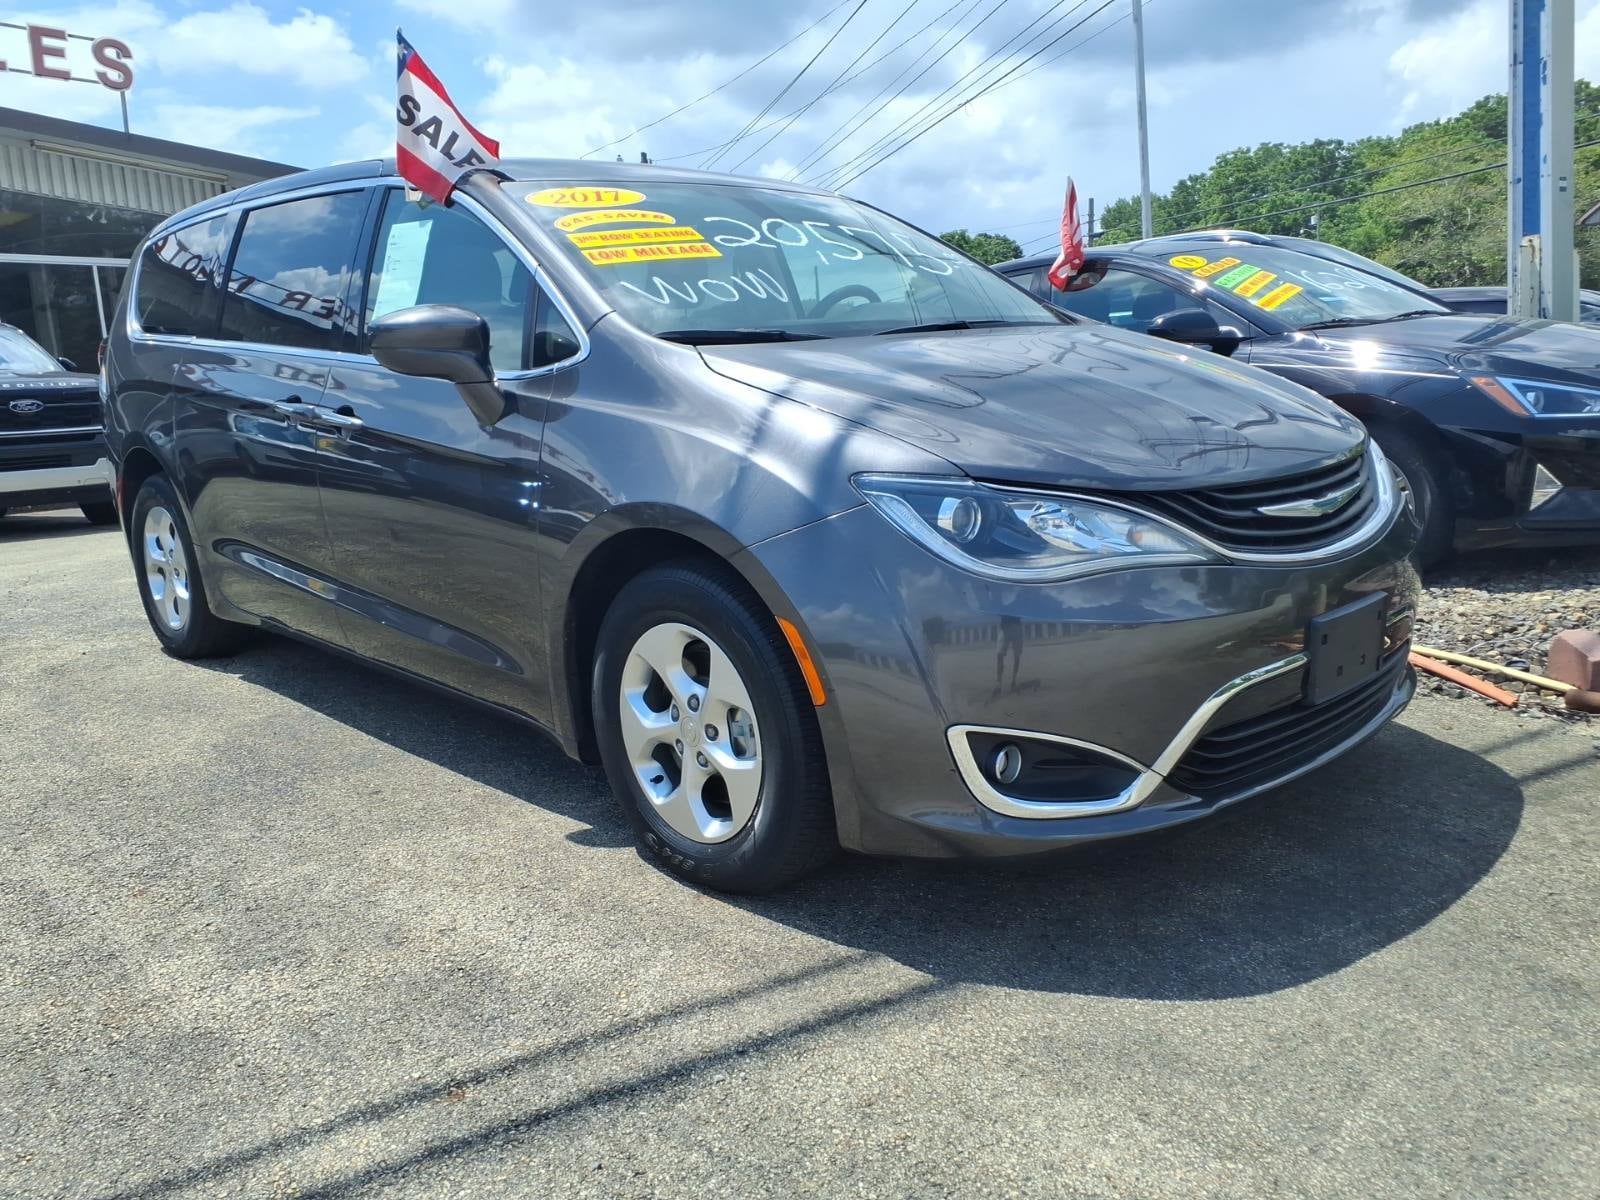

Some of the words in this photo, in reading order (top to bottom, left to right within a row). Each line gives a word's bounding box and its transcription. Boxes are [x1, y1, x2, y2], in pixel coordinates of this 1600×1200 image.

[0, 25, 133, 91] ES
[396, 94, 487, 169] SALE
[549, 190, 620, 205] 2017
[561, 214, 594, 228] GAS
[602, 211, 666, 221] SAVER
[599, 233, 634, 243] ROW
[636, 229, 698, 239] SEATING
[588, 247, 627, 262] LOW
[632, 242, 714, 258] MILEAGE
[619, 267, 789, 305] WOW
[16, 400, 38, 411] Ford
